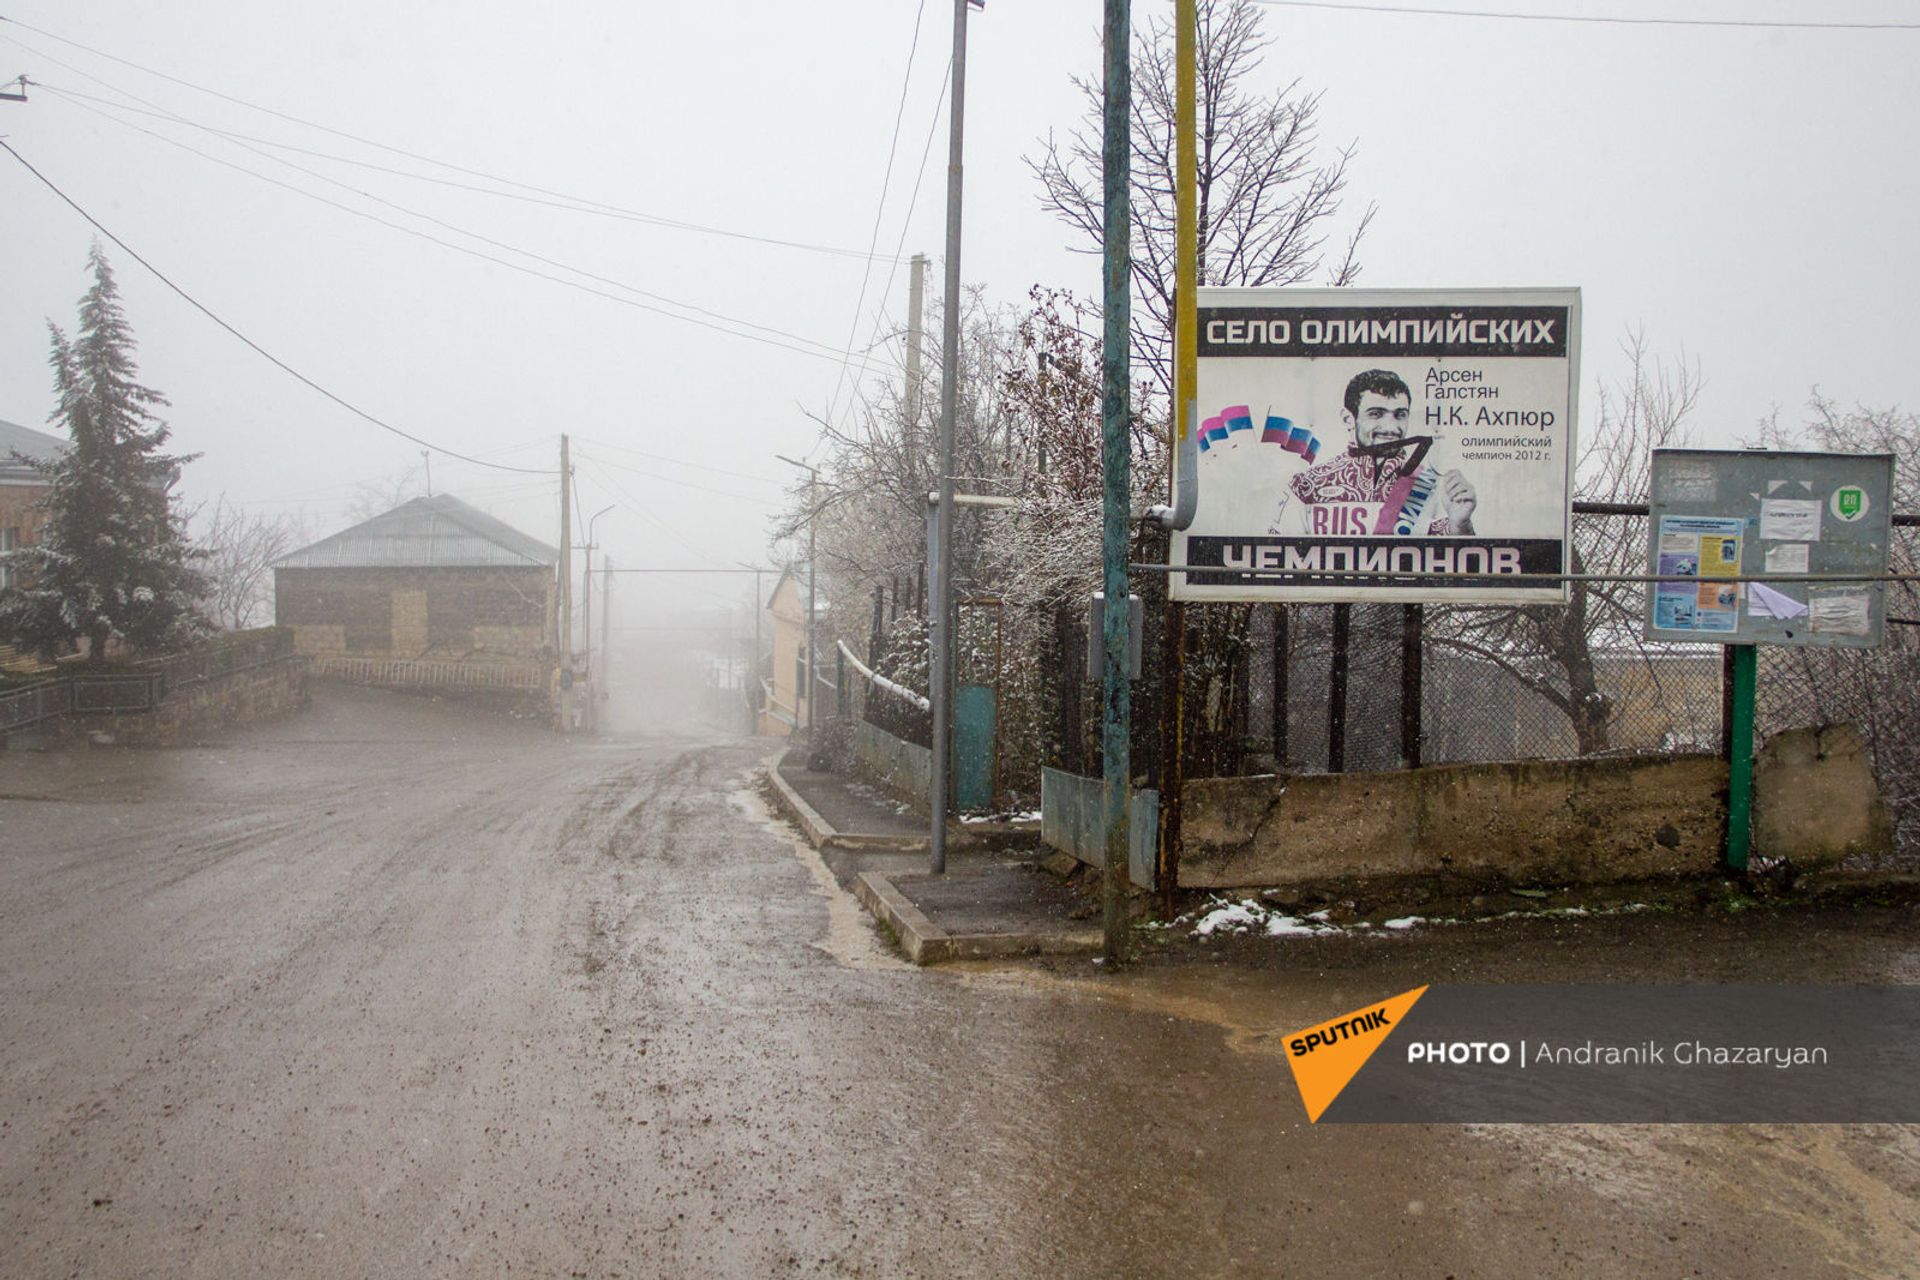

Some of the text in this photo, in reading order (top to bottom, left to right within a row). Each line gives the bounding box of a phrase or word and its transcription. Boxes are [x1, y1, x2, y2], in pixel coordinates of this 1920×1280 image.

[1206, 312, 1555, 345] СЕЛО ОЛИМПИЙСКИХ
[1425, 367, 1483, 385] Арсен
[1425, 384, 1499, 400] Галстян
[1425, 405, 1555, 431] Н.К. Ахпюр
[1461, 435, 1552, 448] олимпийский
[1462, 450, 1552, 461] чемпион 2012 г.
[1222, 544, 1522, 580] ЧЕМПИОНОВ
